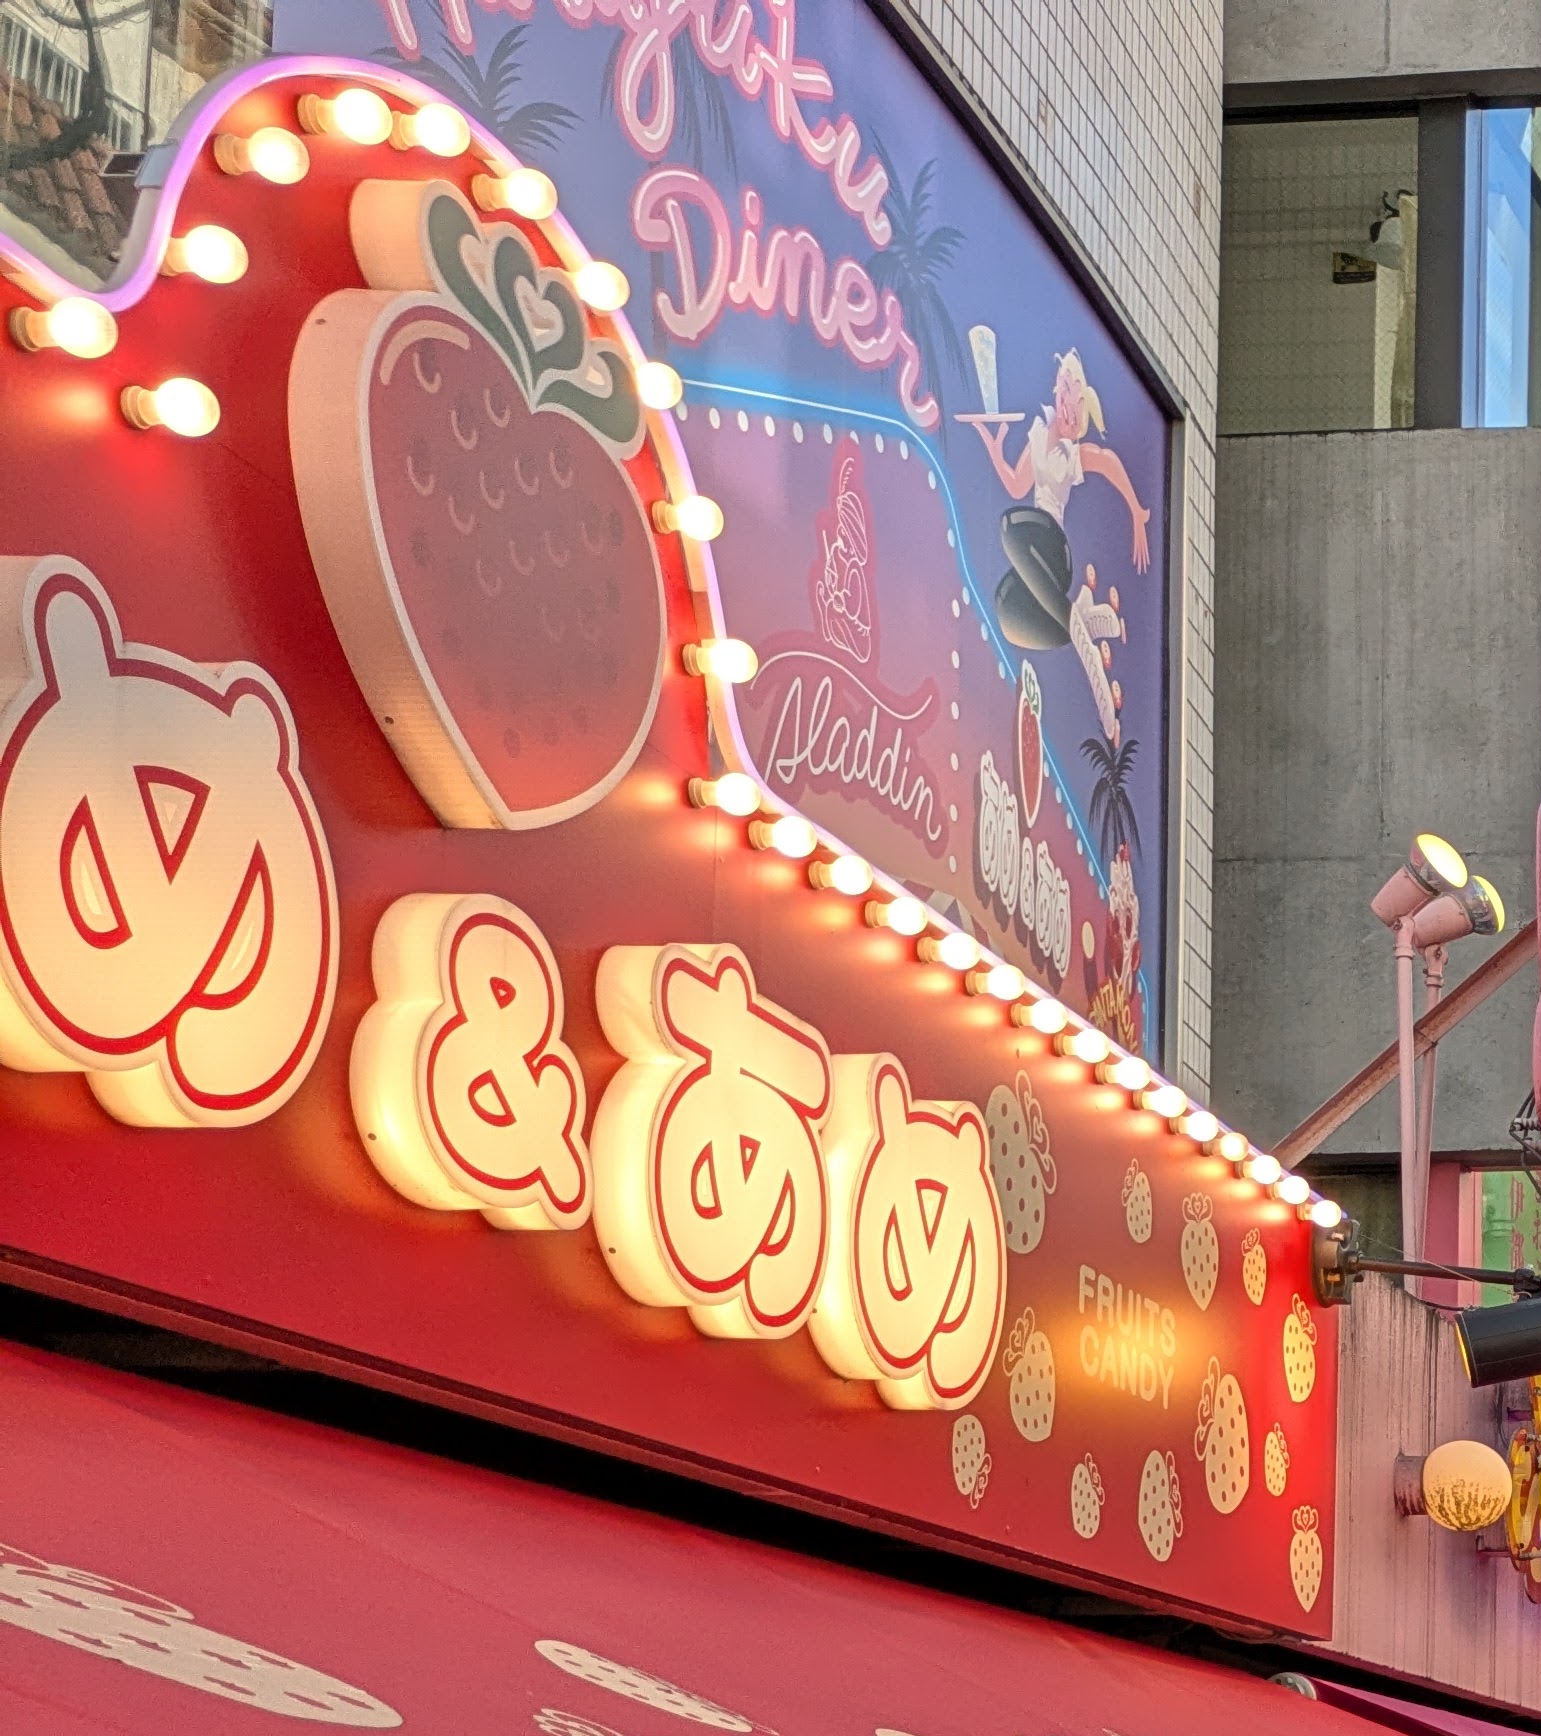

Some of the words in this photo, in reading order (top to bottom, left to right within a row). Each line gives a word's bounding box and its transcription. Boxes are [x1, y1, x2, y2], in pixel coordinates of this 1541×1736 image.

[632, 164, 940, 431] Diner
[764, 676, 941, 842] Aladdin
[1079, 1264, 1176, 1358] FRUITS
[1080, 1325, 1175, 1410] CANDY
